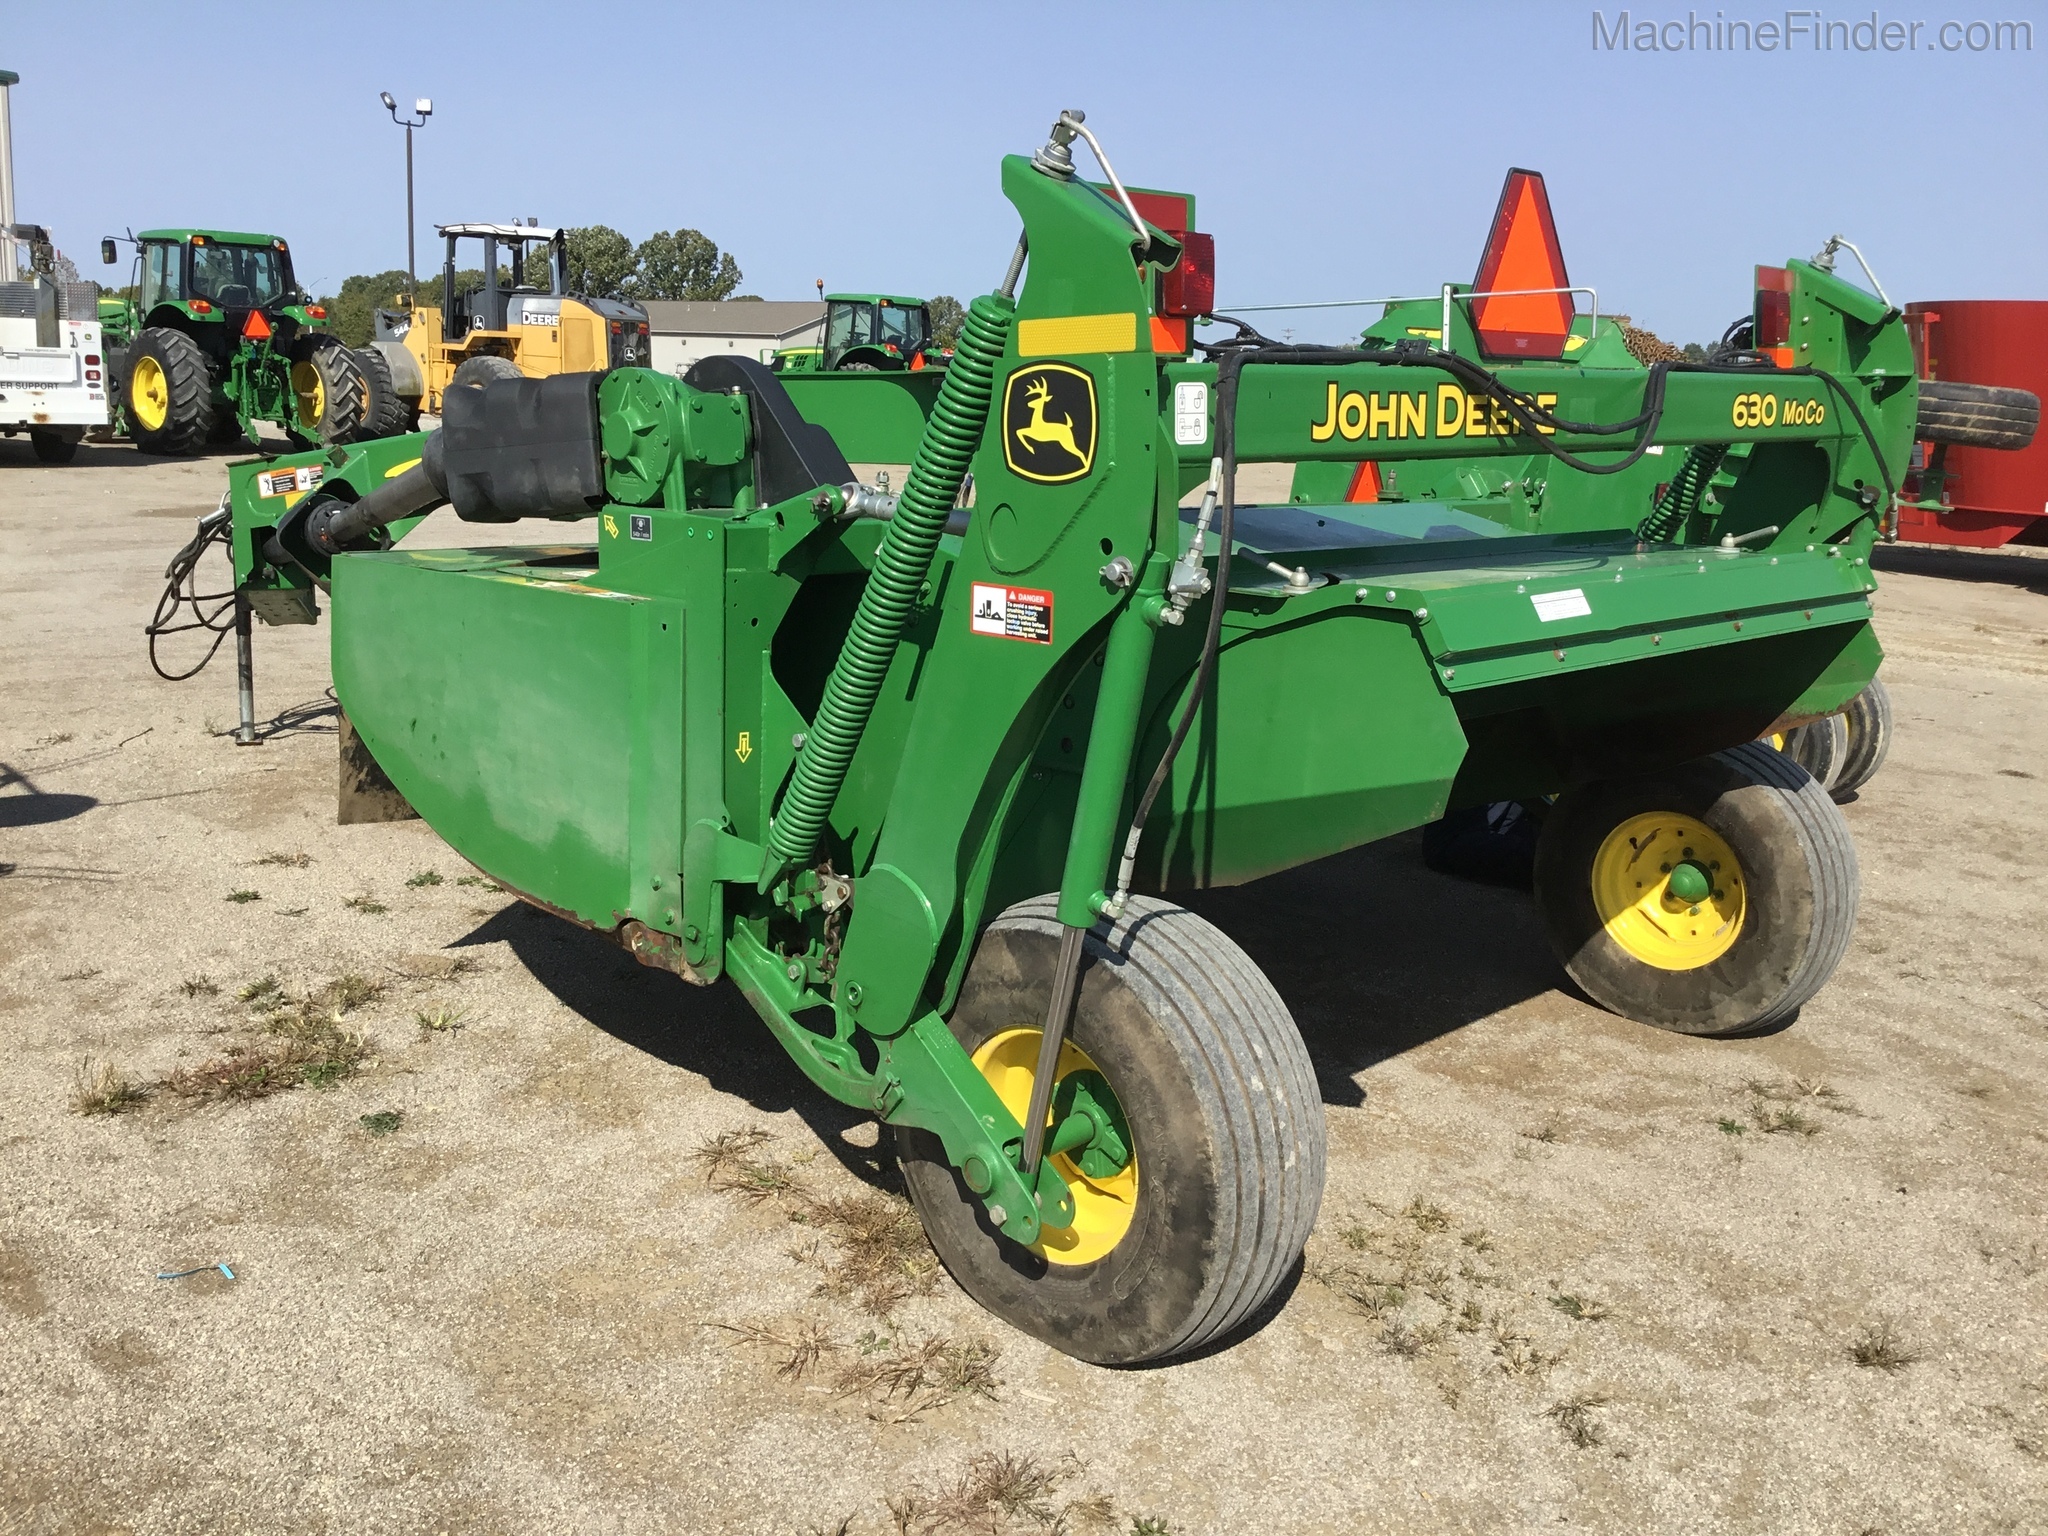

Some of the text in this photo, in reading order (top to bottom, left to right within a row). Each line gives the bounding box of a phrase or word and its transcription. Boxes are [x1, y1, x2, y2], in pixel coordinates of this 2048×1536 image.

[522, 311, 559, 326] DEERE
[15, 382, 59, 390] SUPPORT
[1311, 381, 1428, 442] JOHN
[1732, 393, 1825, 428] 630 MoCo
[1018, 593, 1045, 603] DANGER
